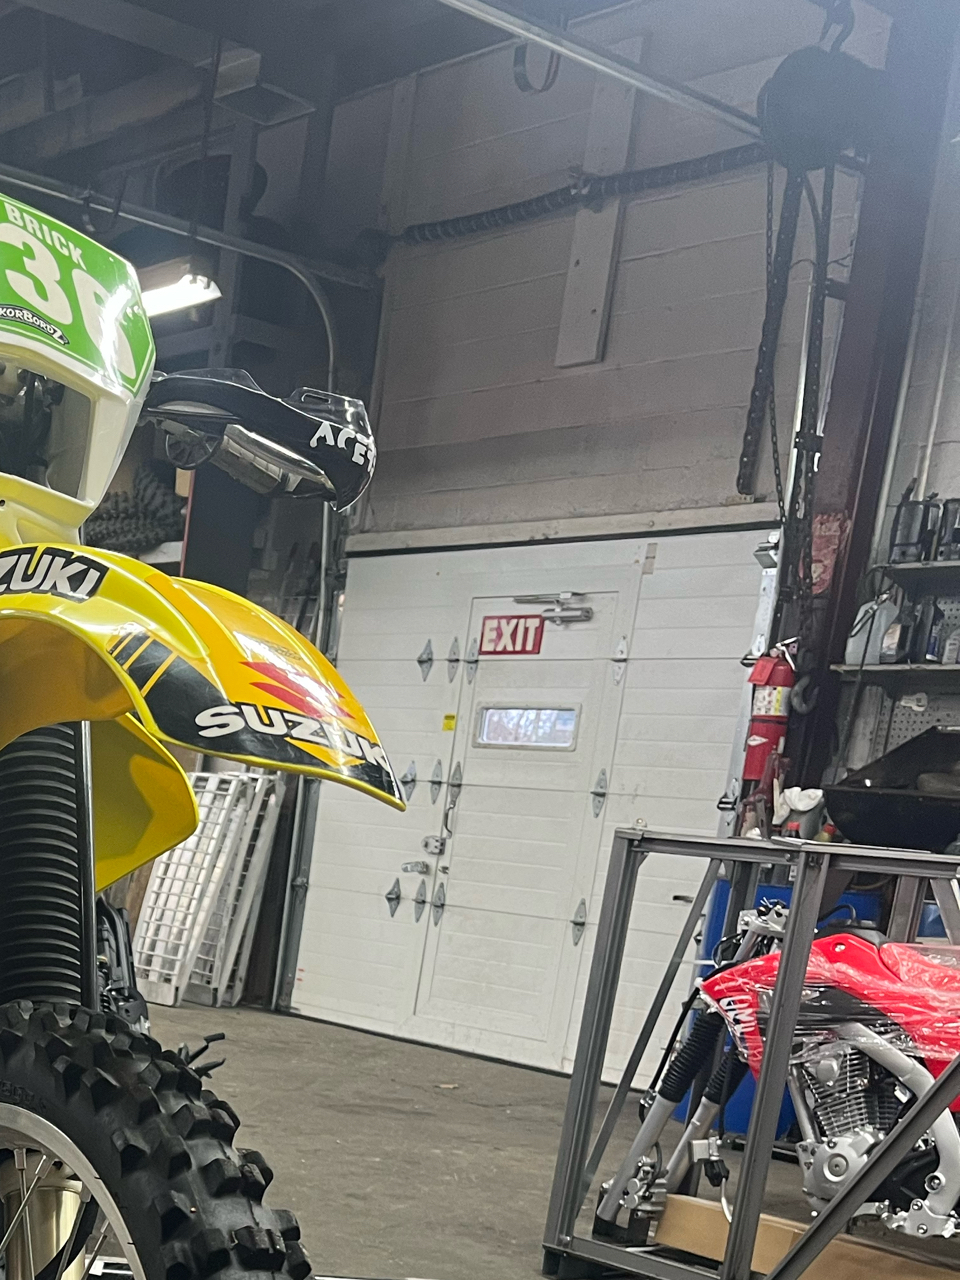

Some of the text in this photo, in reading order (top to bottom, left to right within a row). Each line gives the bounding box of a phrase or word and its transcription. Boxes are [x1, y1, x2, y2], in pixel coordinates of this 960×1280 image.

[7, 202, 88, 271] BRICK
[481, 618, 540, 651] EXIT
[194, 704, 392, 773] SUZUK
